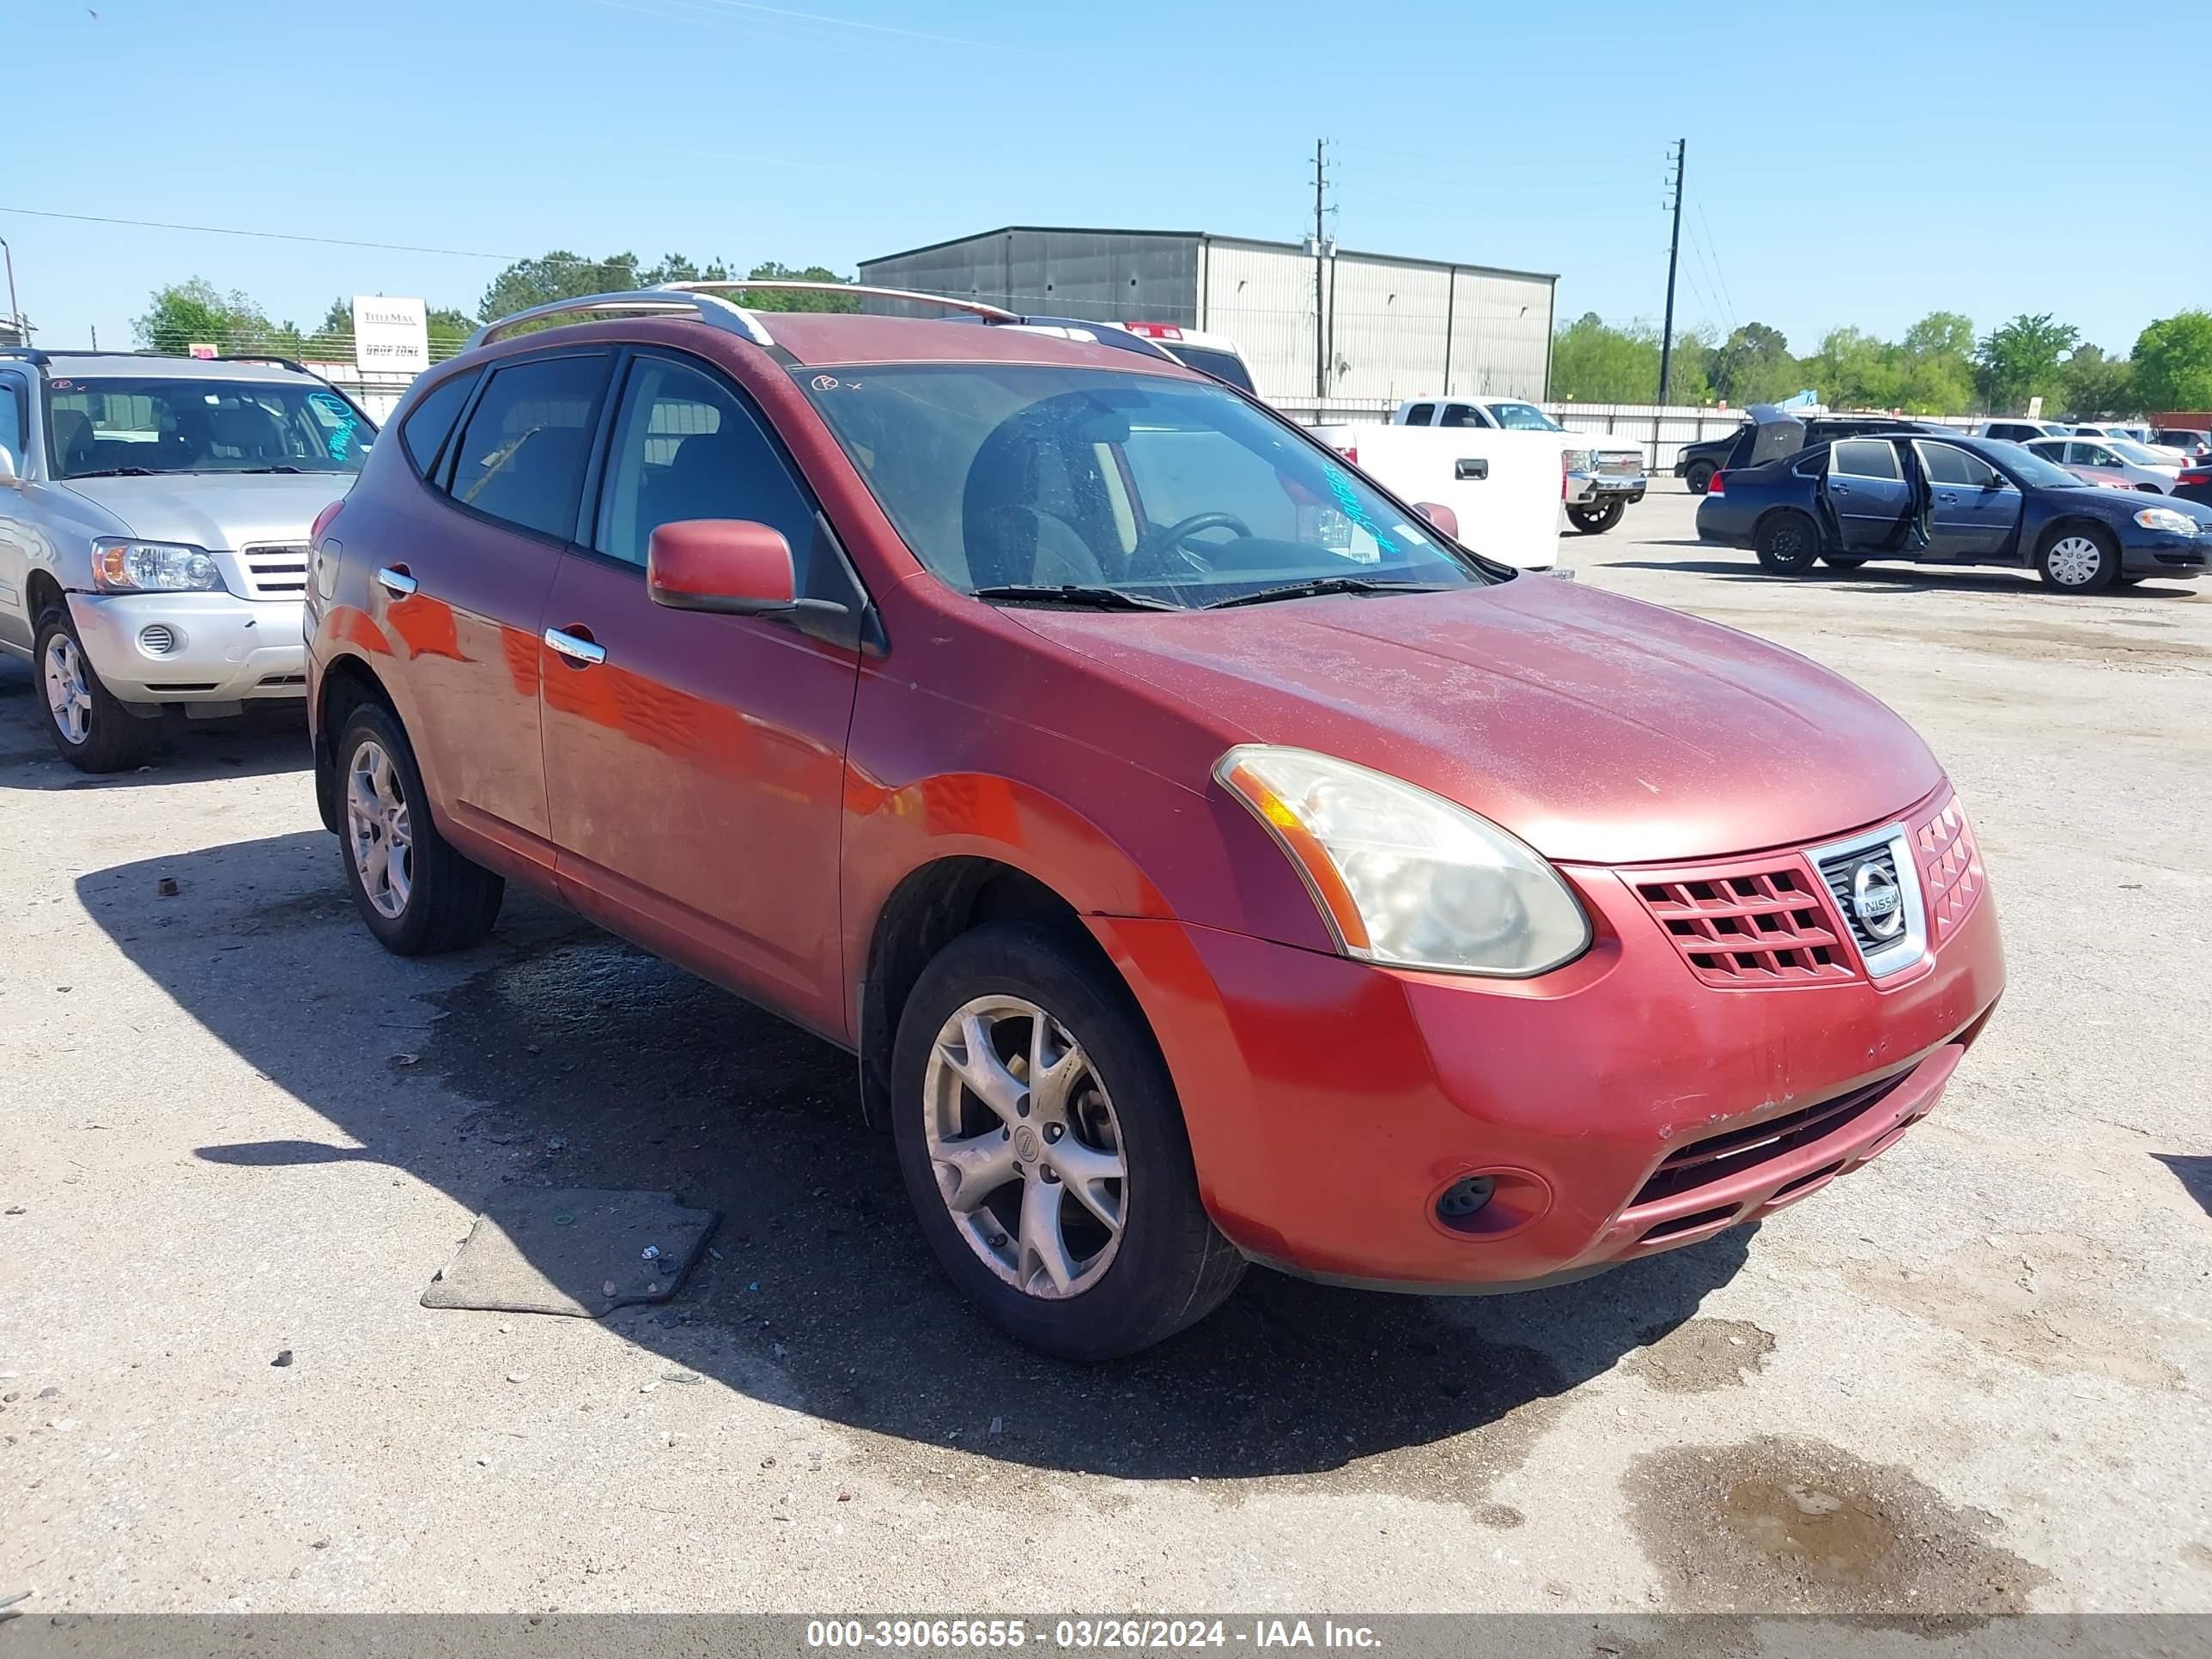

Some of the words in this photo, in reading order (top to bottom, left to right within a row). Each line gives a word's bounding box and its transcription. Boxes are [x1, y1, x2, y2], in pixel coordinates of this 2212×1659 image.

[366, 344, 393, 356] DROP
[394, 345, 419, 356] ZONE
[1864, 893, 1899, 912] NISSAN
